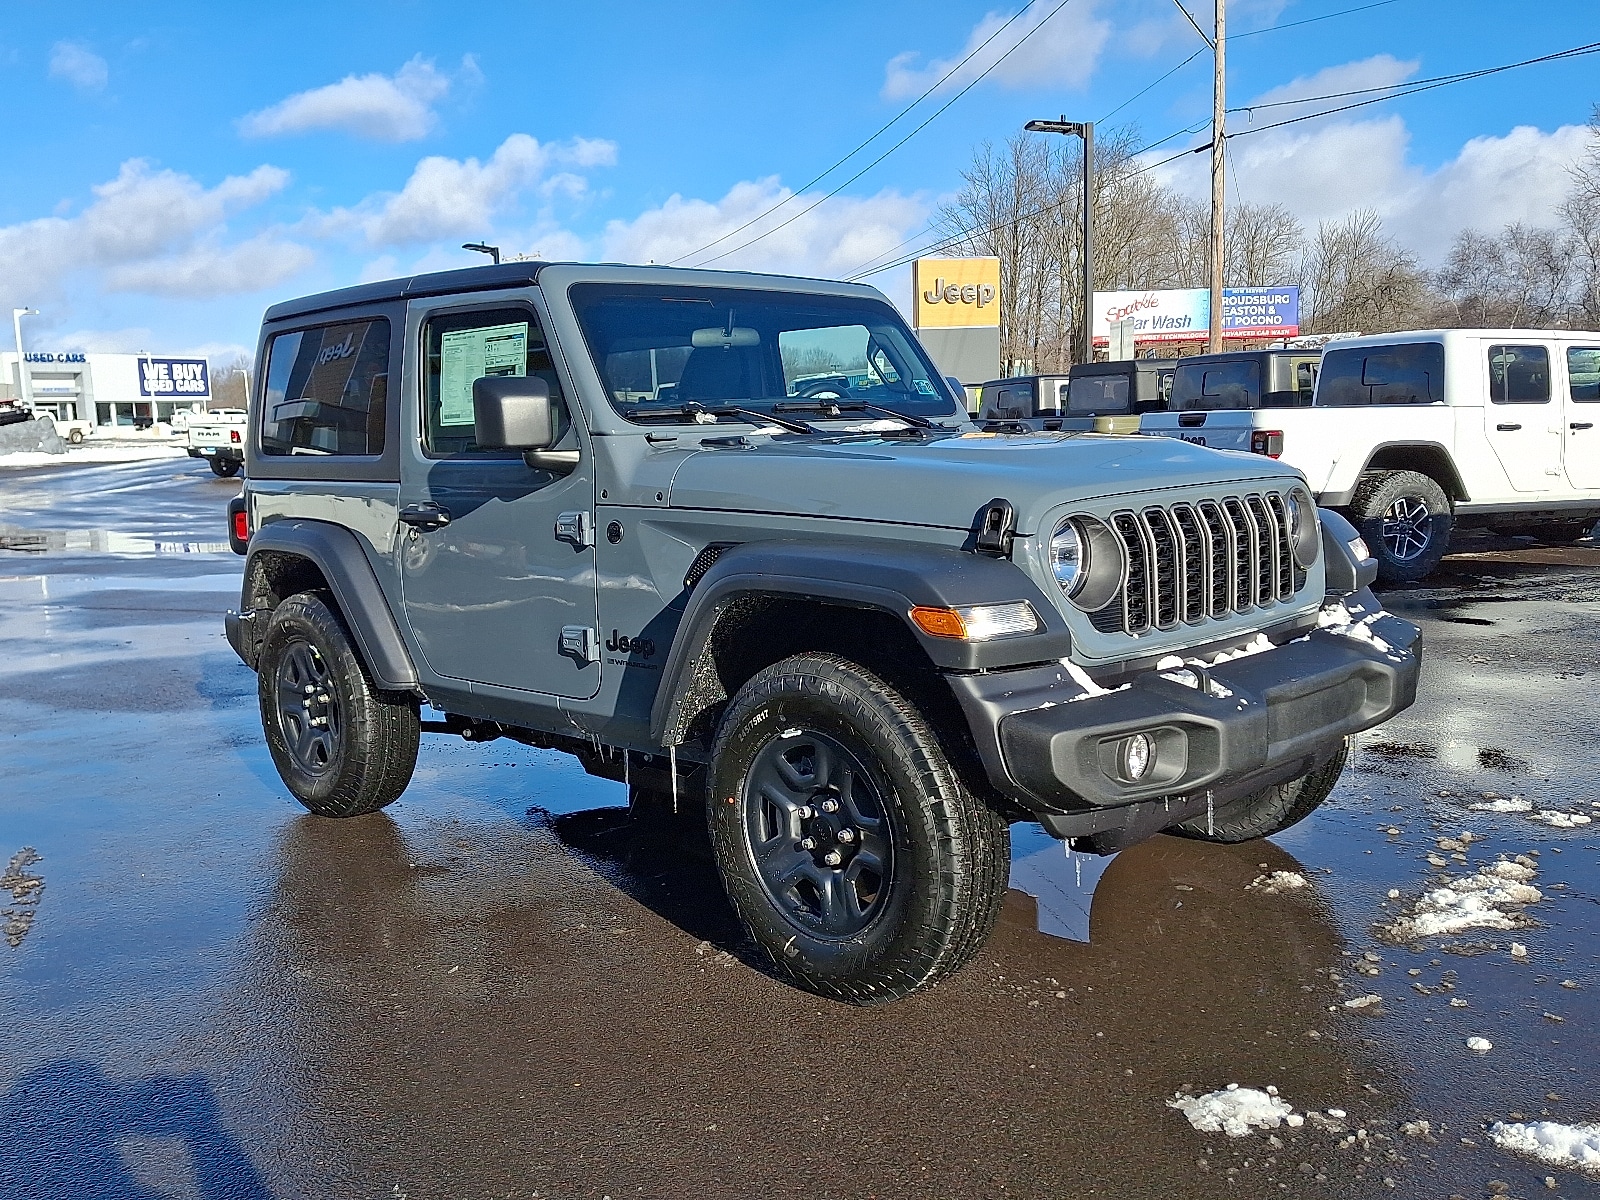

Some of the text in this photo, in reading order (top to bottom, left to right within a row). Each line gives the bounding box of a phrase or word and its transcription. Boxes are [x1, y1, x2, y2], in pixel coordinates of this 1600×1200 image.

[924, 277, 995, 308] Jeep
[1222, 295, 1290, 305] ROUDSBURG
[1105, 293, 1159, 322] Sparkle
[1224, 306, 1276, 316] EASTON &
[1153, 315, 1191, 330] Wash
[1235, 315, 1282, 326] POCONO
[1161, 331, 1209, 340] TECHNOLOGICA
[25, 353, 86, 362] USED CARS
[142, 363, 203, 380] WE BUY
[144, 380, 206, 392] USED CARS
[605, 629, 655, 660] Jeep
